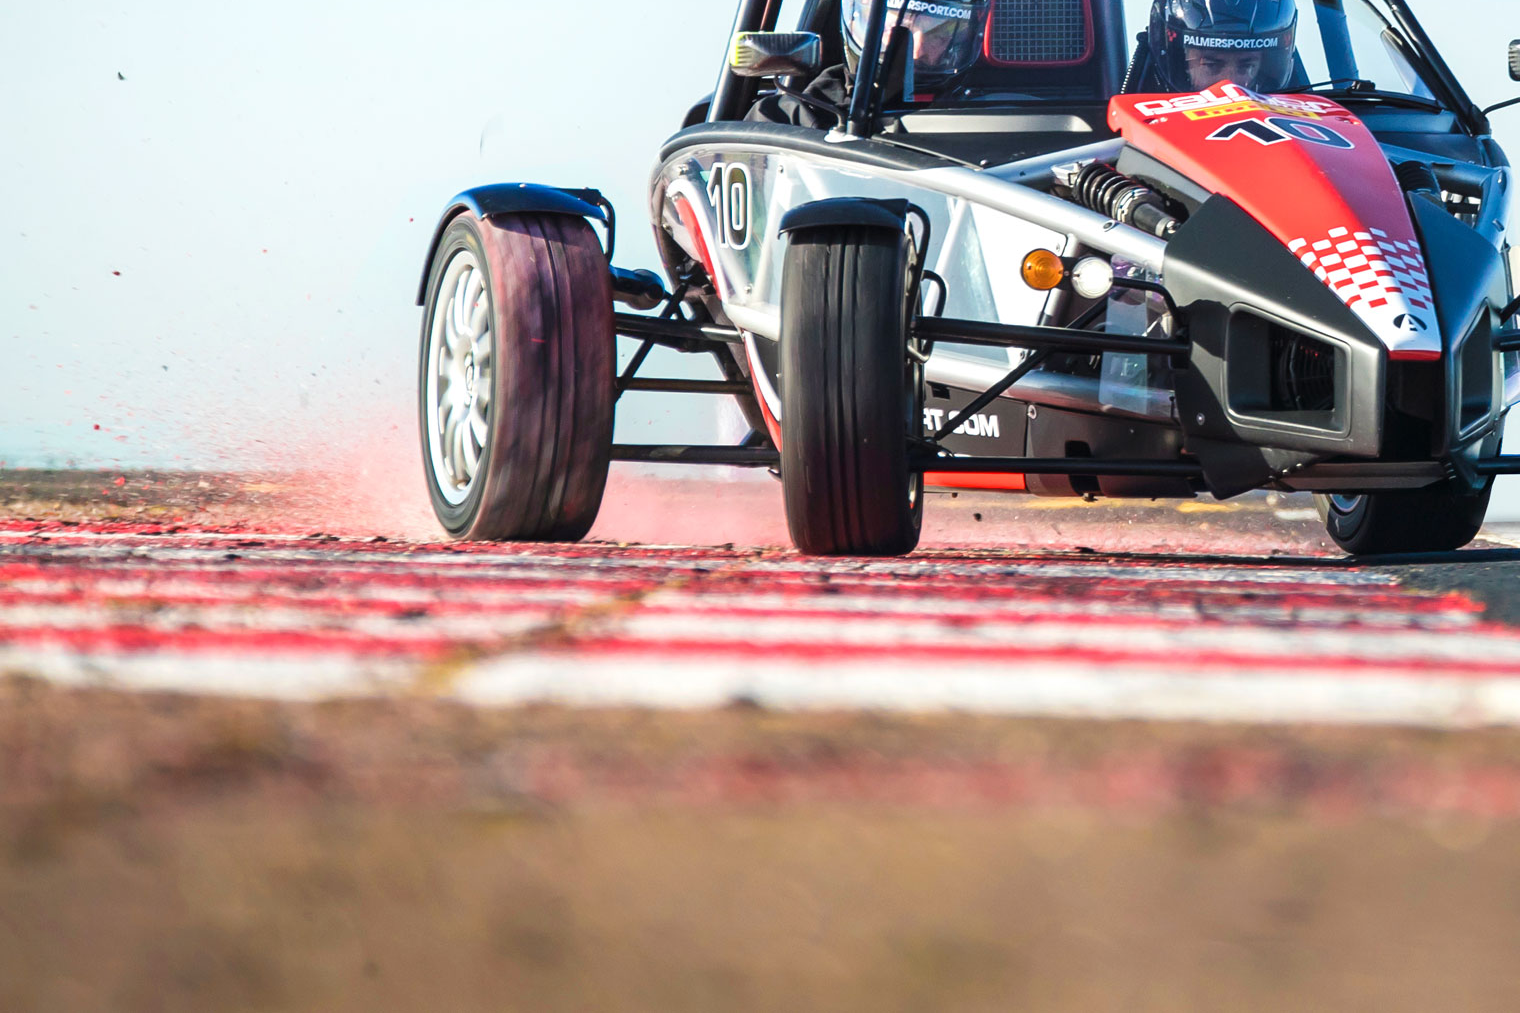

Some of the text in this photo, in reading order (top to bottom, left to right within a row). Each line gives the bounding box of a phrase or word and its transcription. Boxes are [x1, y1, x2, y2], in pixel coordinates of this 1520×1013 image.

[1183, 34, 1278, 48] PALMERSPORT.COM
[1205, 116, 1355, 150] 10
[706, 162, 752, 251] 10
